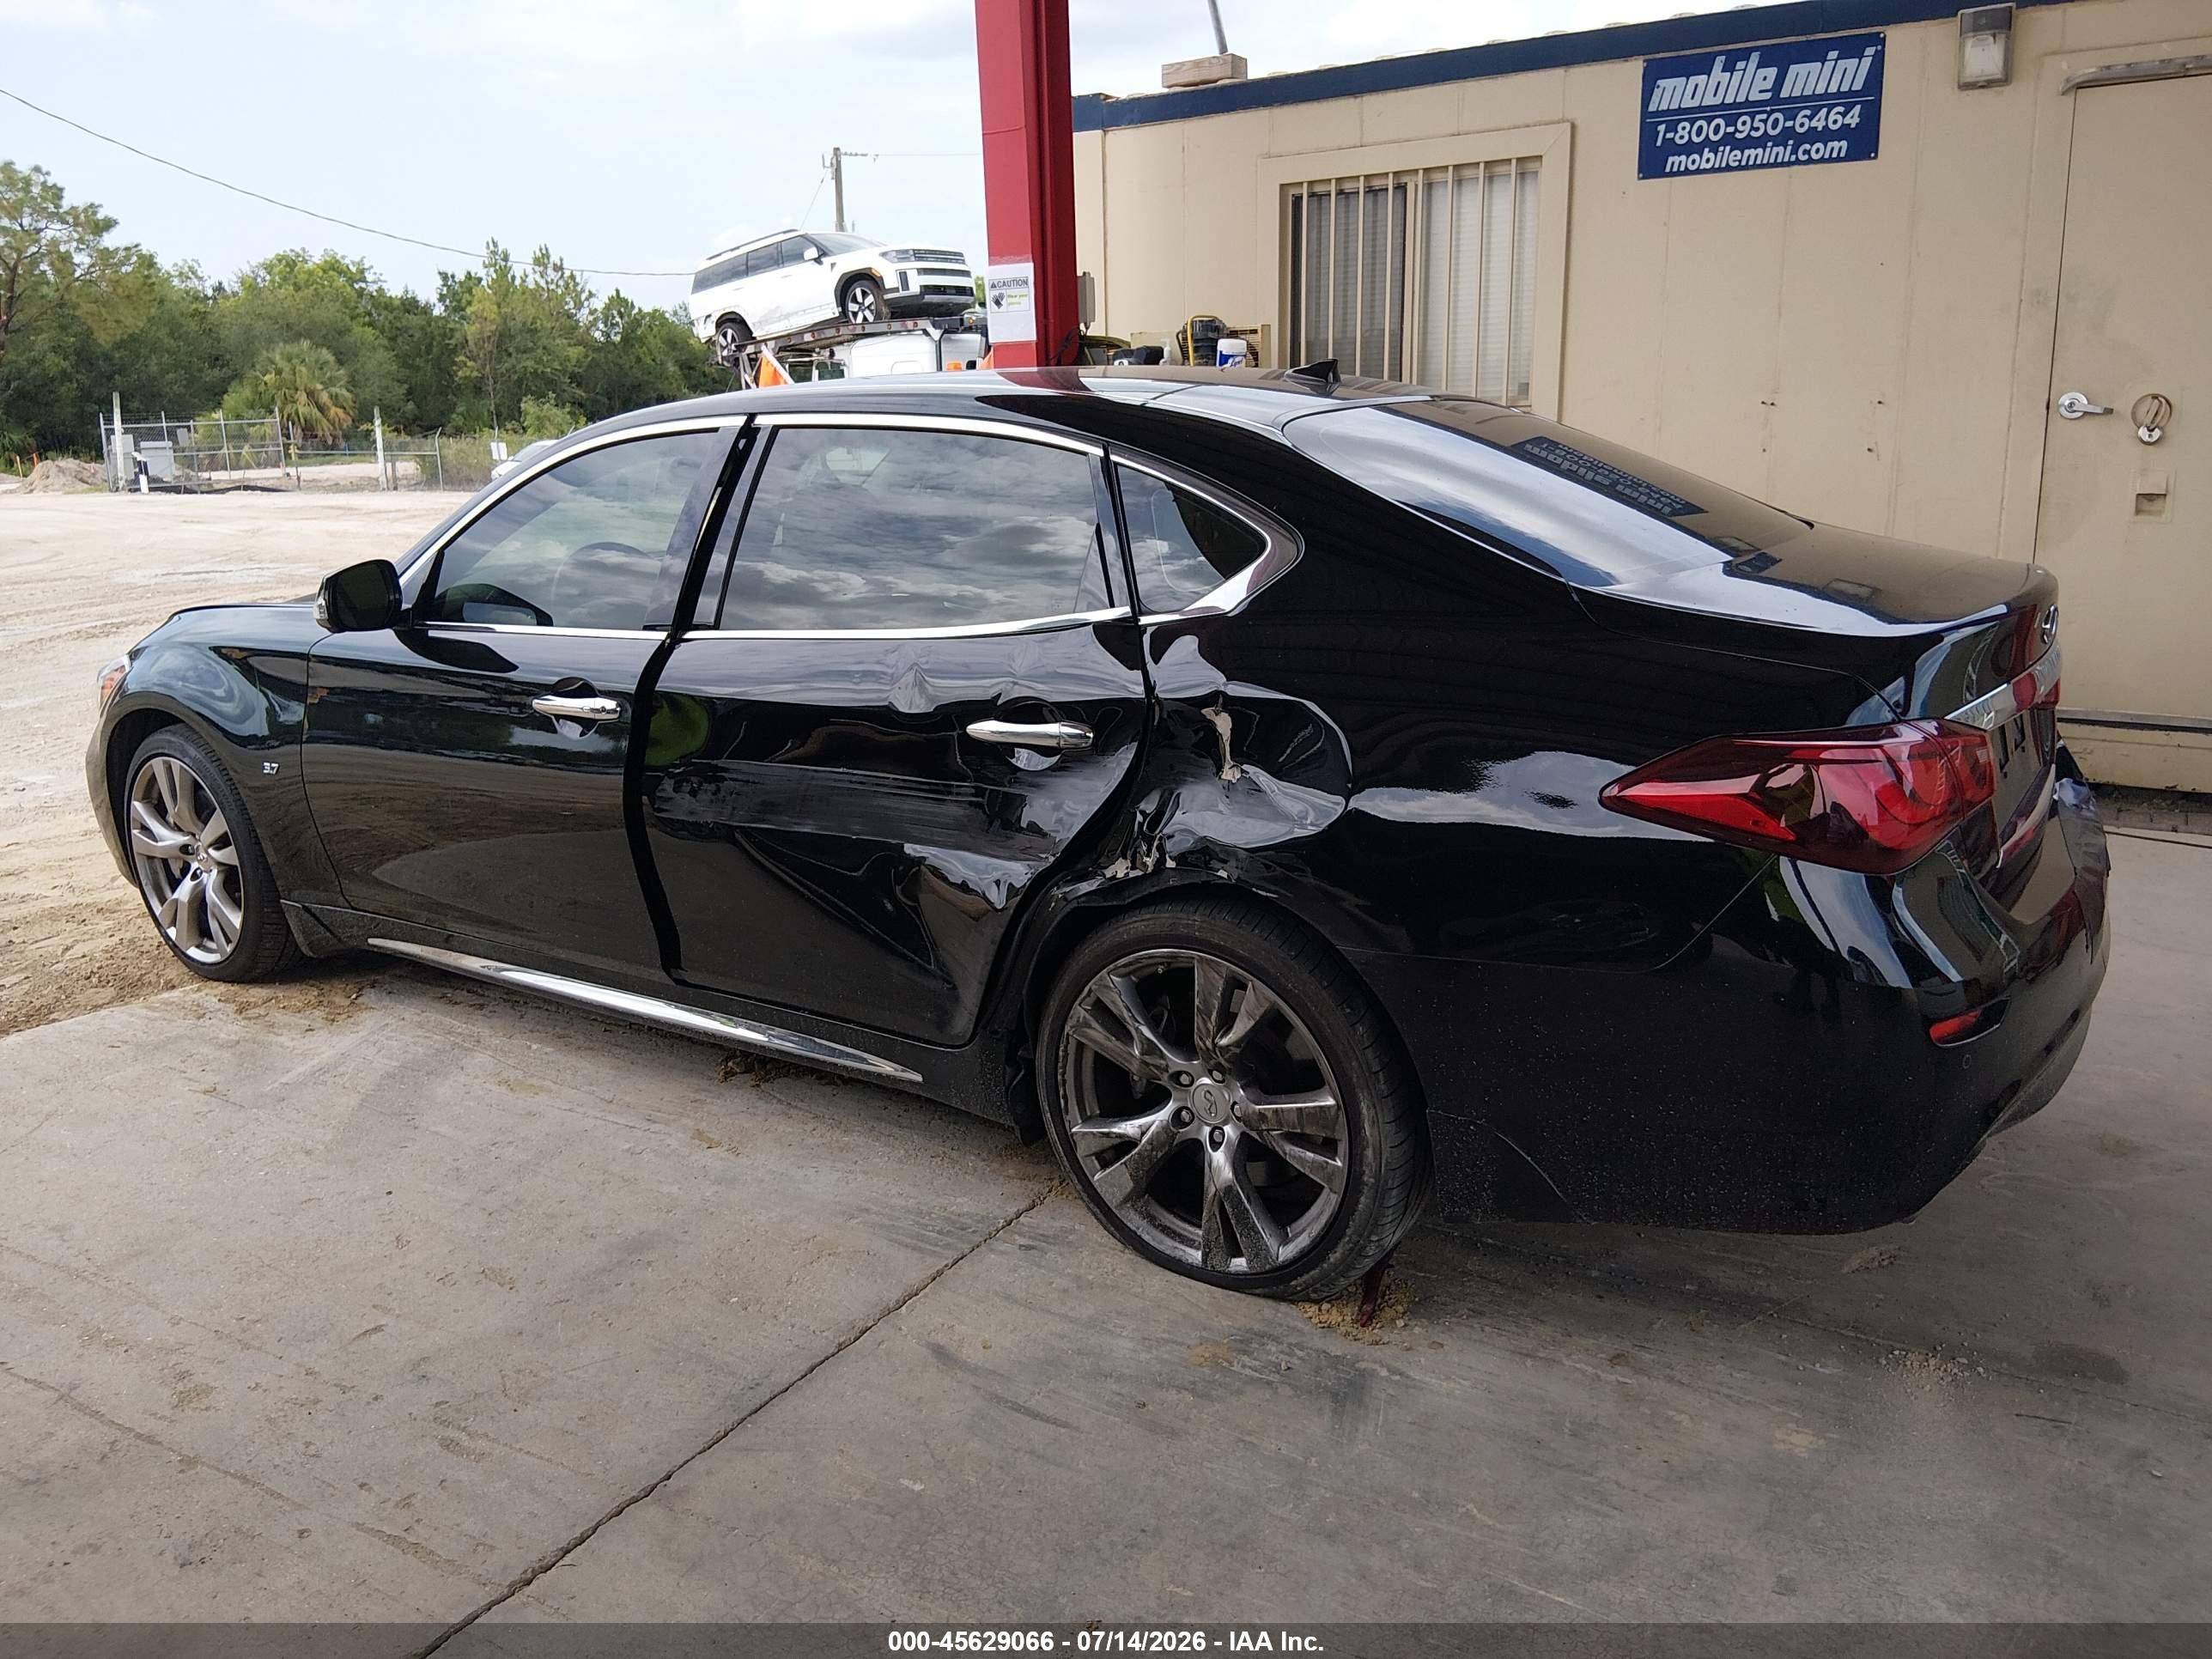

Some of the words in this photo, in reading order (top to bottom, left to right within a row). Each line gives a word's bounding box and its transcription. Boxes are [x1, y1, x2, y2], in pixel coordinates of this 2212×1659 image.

[1648, 52, 1778, 112] mobile
[1779, 46, 1876, 99] mini
[1656, 104, 1862, 147] 1-800-950-6464
[1664, 139, 1848, 173] mobilemini.com
[996, 278, 1029, 289] CAUTION
